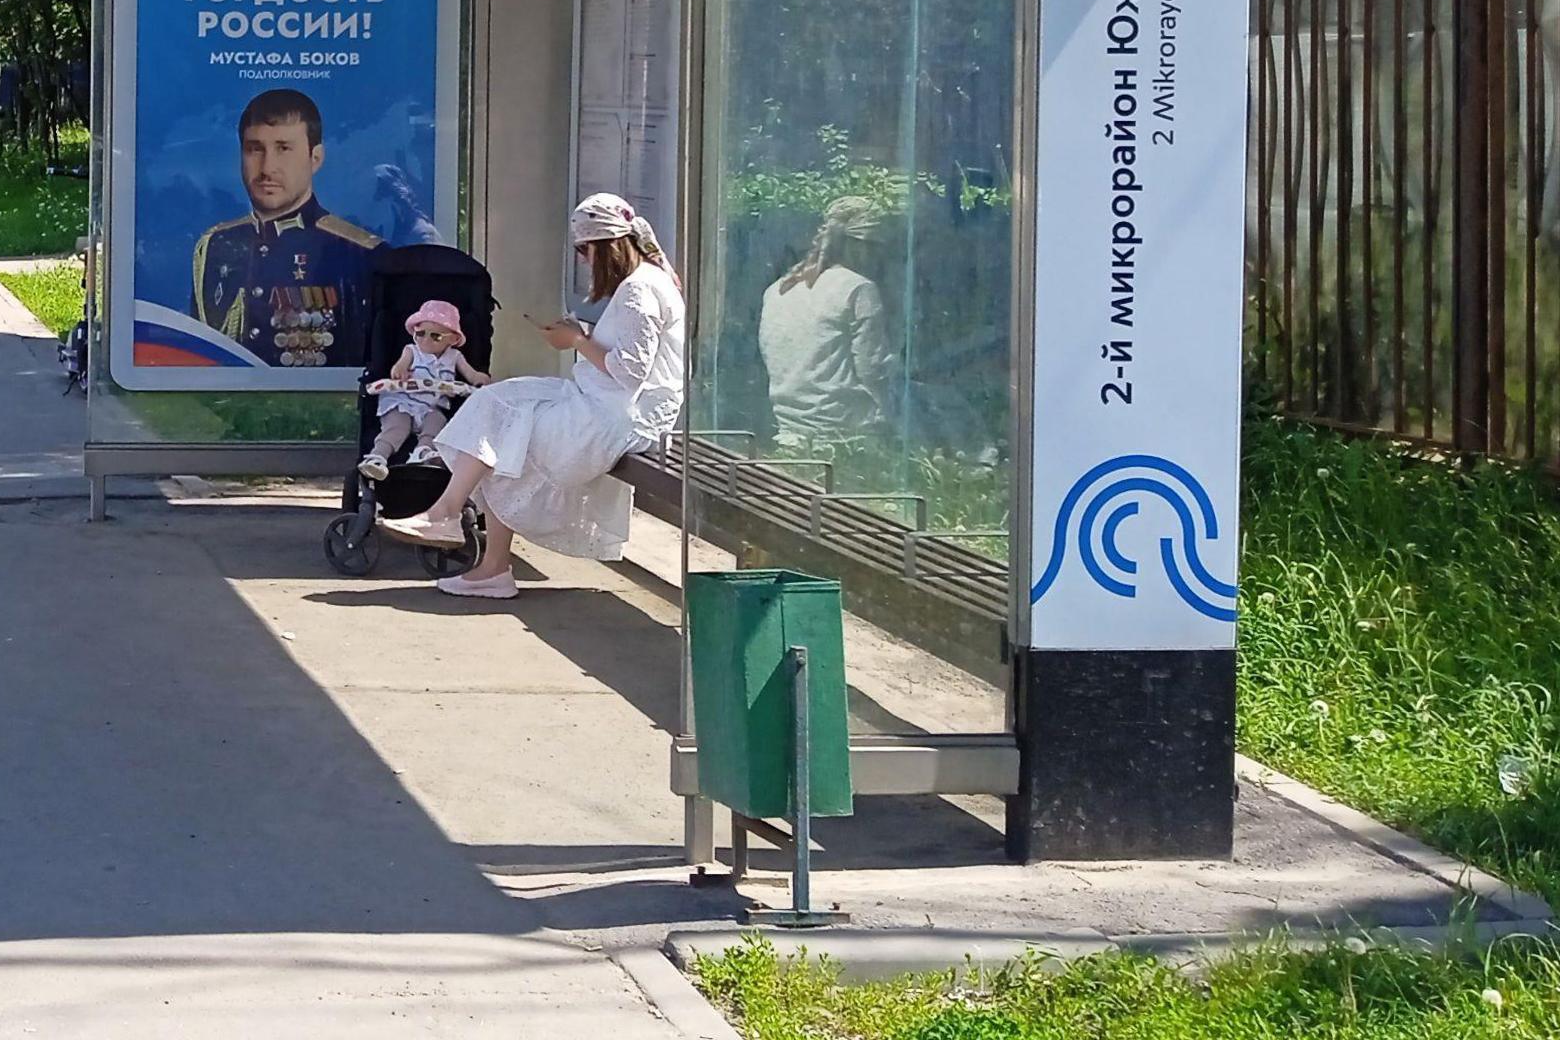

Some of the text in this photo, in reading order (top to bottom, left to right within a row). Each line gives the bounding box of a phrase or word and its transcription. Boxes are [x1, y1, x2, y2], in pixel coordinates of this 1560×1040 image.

[197, 11, 373, 39] РОССИИ!
[209, 52, 360, 65] МУСТАФА БОКОВ
[238, 69, 331, 80] ПОДПОЛКОВНИК
[1152, 129, 1174, 146] 2
[1104, 69, 1143, 328] микрорайон
[1100, 340, 1133, 405] 2-й
